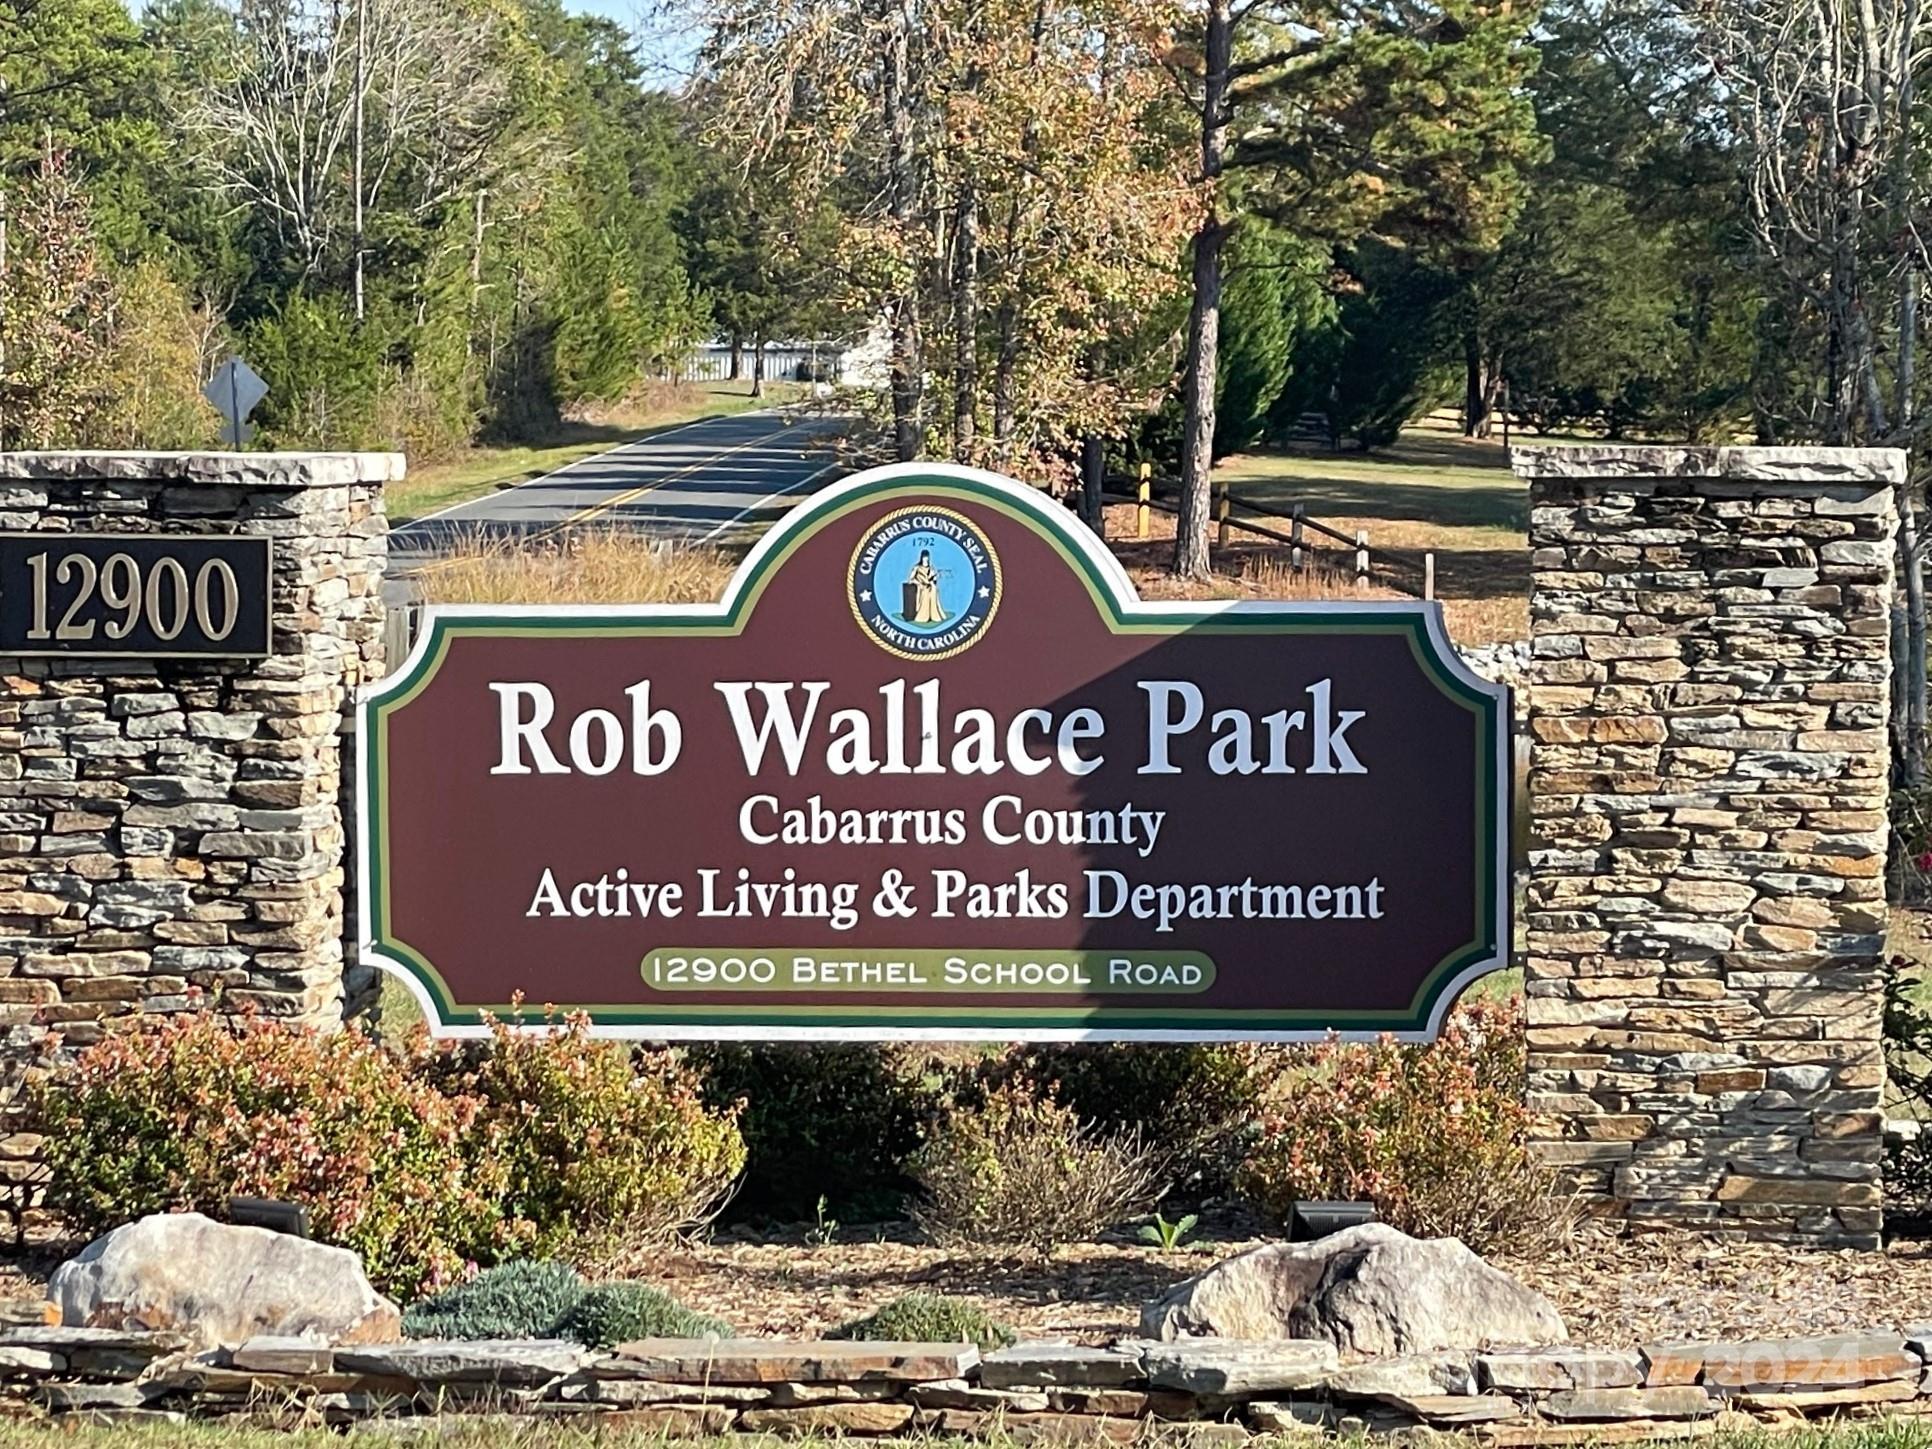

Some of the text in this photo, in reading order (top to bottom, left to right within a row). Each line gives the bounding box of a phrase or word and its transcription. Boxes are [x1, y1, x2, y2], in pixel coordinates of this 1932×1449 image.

[860, 516, 988, 575] CABARRUS COUNTY SEAL
[912, 537, 935, 547] 1792
[26, 552, 239, 641] 12900
[871, 614, 981, 650] NORTH CAROLINA
[489, 678, 1368, 776] Rob Wallace Park
[739, 795, 1166, 857] Cabarrus County
[526, 868, 1385, 932] Active Living & Parks Department
[653, 957, 776, 984] 12900
